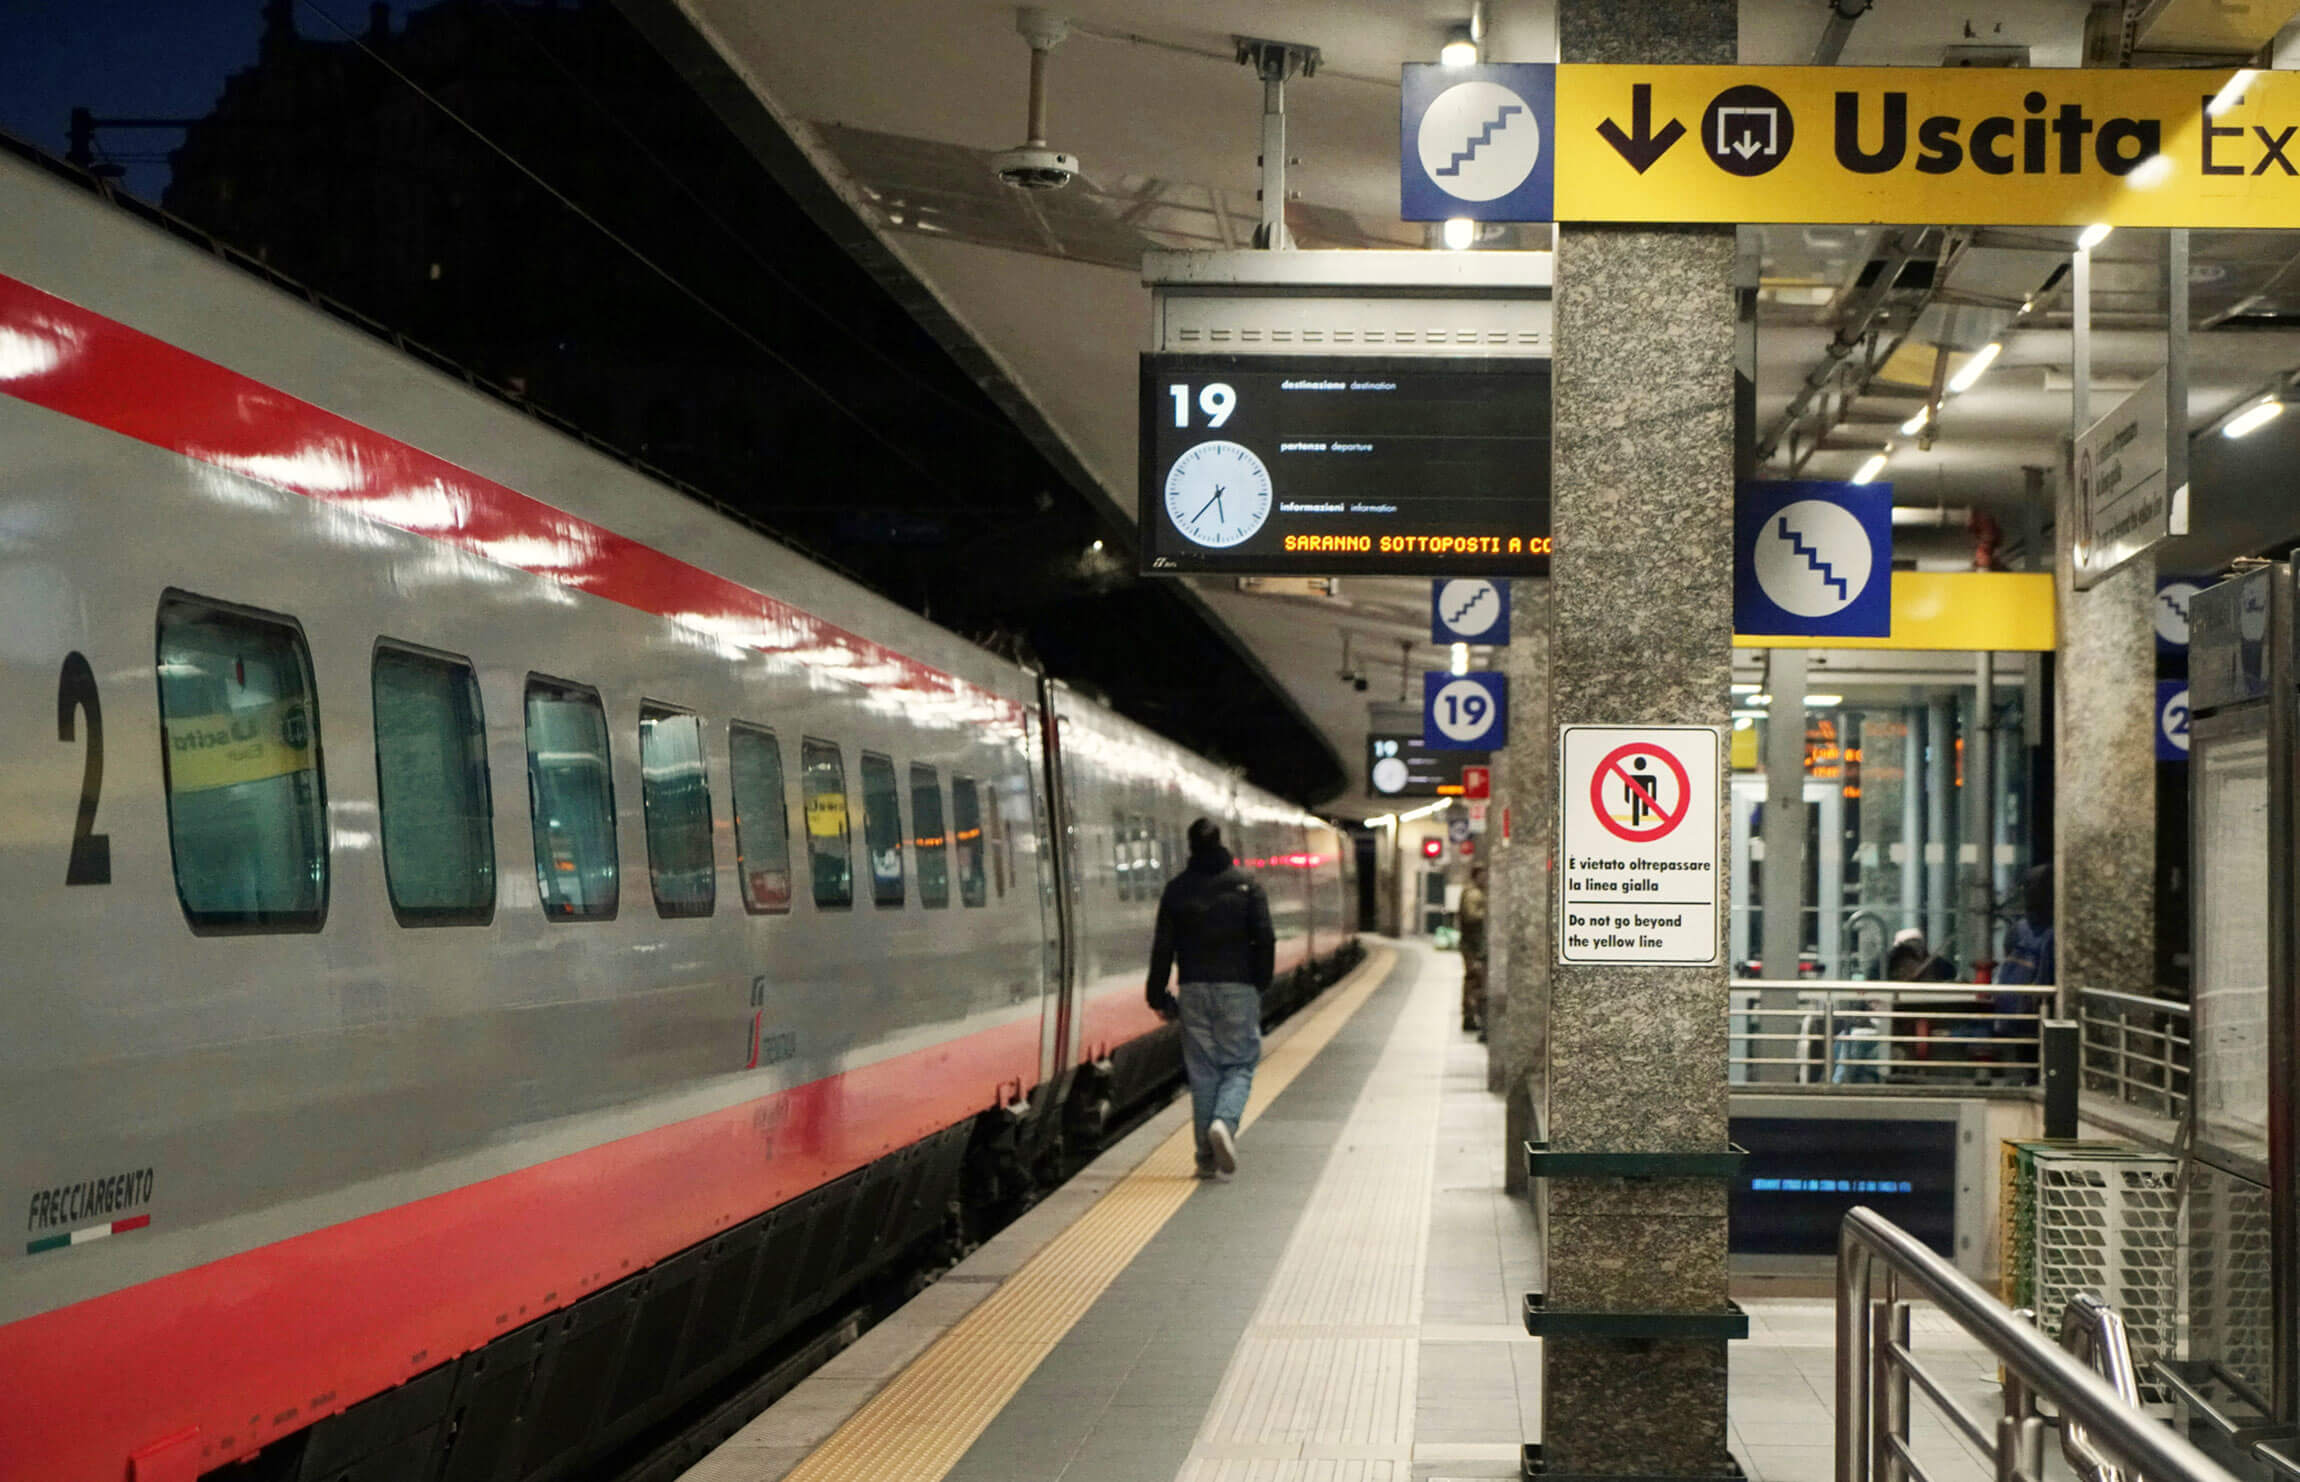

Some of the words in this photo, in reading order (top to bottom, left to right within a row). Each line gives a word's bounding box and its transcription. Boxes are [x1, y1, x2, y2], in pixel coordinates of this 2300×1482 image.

[1834, 91, 2161, 176] Uscita
[1281, 380, 1346, 391] destinazione
[1350, 381, 1397, 391] destination
[1169, 382, 1237, 428] 19
[1280, 442, 1327, 453] partenza
[1330, 441, 1373, 453] departure
[1280, 501, 1345, 512] informazioni
[1350, 502, 1397, 513] information
[1284, 535, 1371, 552] SARANNO
[1379, 536, 1500, 553] SOTTOPOSTI
[1508, 537, 1522, 553] A
[1444, 695, 1487, 725] 19
[58, 651, 111, 886] 2
[1580, 857, 1625, 870] vietato
[1629, 857, 1711, 873] oltrepassare
[1569, 878, 1581, 891] la
[1585, 878, 1618, 891] linea
[1622, 878, 1659, 894] gialla
[1569, 914, 1586, 927] Do
[1590, 915, 1611, 927] not
[1614, 918, 1631, 929] go
[1634, 914, 1682, 929] beyond
[1568, 934, 1589, 947] the
[1593, 934, 1635, 950] yellow
[1639, 935, 1663, 948] line
[27, 1168, 154, 1231] FRECCIARGENTO
